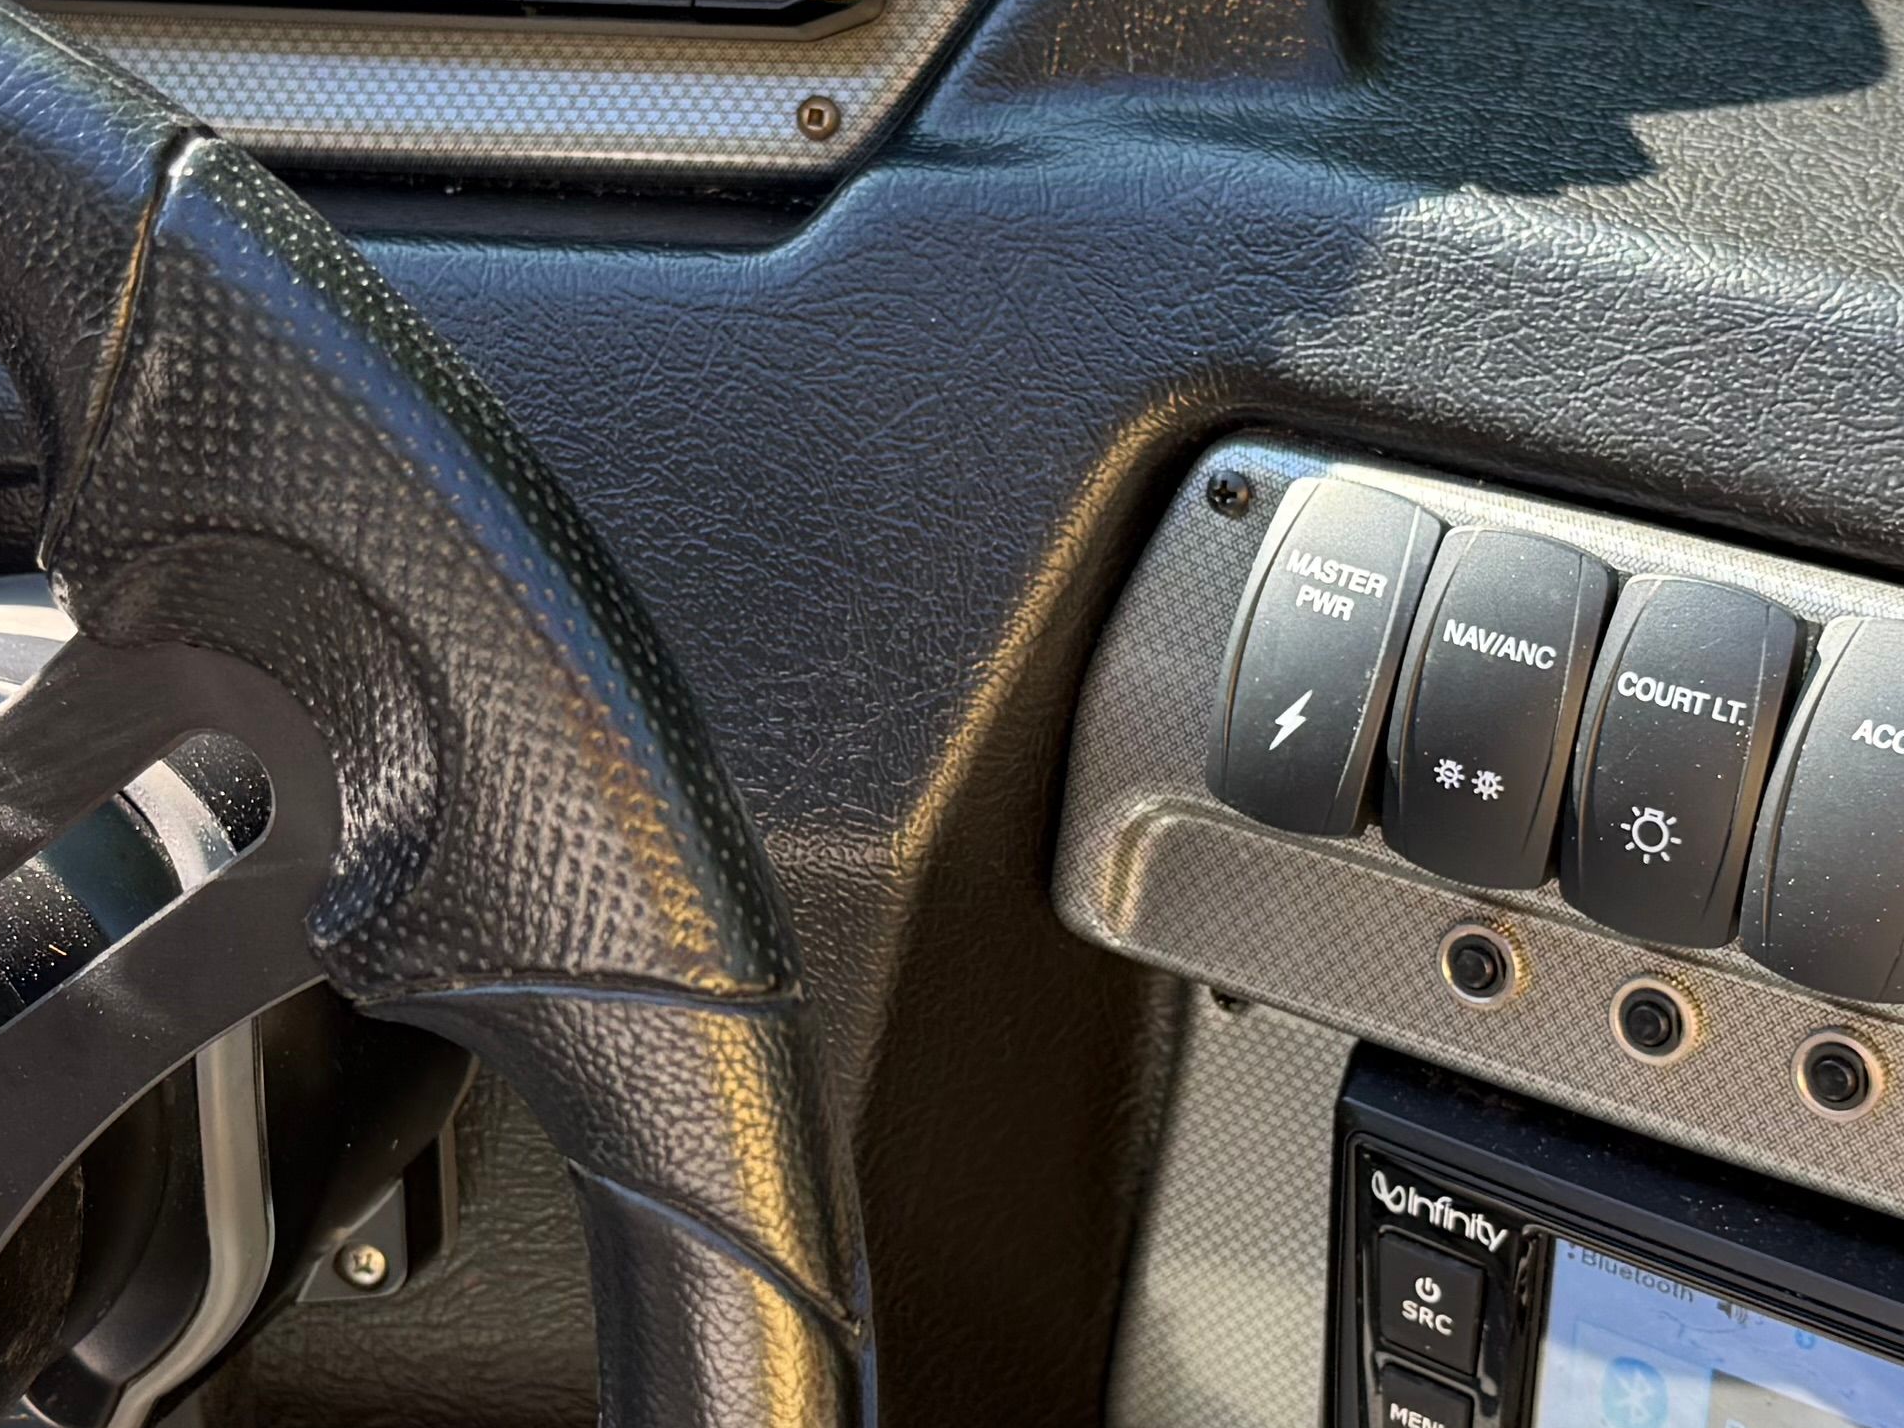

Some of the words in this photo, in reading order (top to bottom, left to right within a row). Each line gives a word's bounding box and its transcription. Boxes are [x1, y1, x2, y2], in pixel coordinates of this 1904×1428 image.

[1286, 549, 1388, 598] MASTER
[1295, 586, 1355, 621] PWR
[1442, 619, 1557, 671] NAV/ANC
[1616, 671, 1710, 717] COURT
[1710, 698, 1749, 727] LT.
[1581, 1248, 1695, 1303] Bluetooth
[1402, 1299, 1454, 1336] SRC
